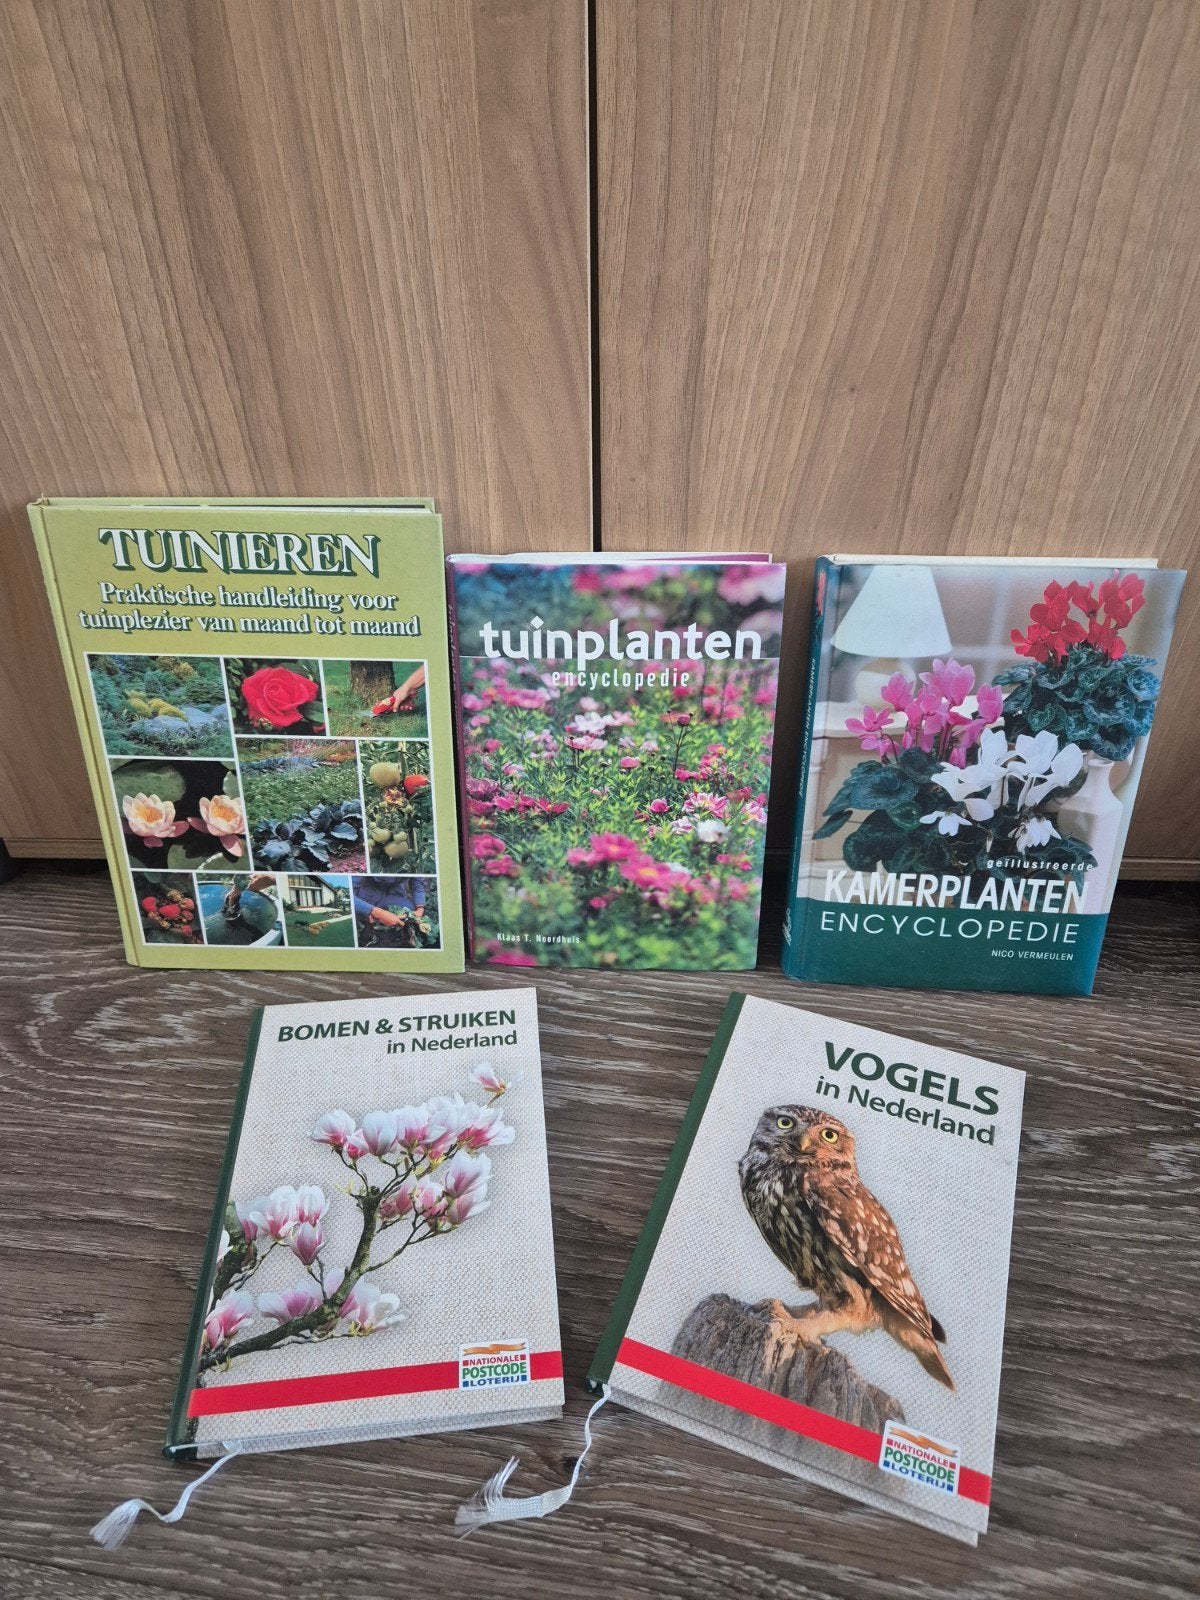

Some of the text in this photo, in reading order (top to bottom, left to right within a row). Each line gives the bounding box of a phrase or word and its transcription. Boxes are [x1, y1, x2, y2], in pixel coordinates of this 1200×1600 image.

[99, 528, 381, 578] TUINIEREN
[99, 581, 398, 613] Praktische handleiding voor
[78, 608, 421, 637] tuinplezier van maand tot maand
[479, 615, 762, 671] tuinplanten
[551, 668, 690, 691] encyclopedie
[986, 857, 1094, 871] geïllustreerde
[824, 869, 1090, 914] KAMERPLANTEN
[497, 932, 580, 944] Klaas T. Noordhuis
[820, 911, 1080, 944] ENCYCLOPEDIE
[991, 949, 1074, 961] NICO VERMEULEN
[277, 1009, 516, 1042] BOMEN & STRUIKEN
[386, 1030, 518, 1054] in Nederland
[825, 1041, 999, 1116] VOGELS
[815, 1075, 995, 1146] in Nederland
[462, 1361, 527, 1379] POSTCODE
[469, 1354, 519, 1366] NATIONALE
[470, 1375, 520, 1387] LOTERIJ
[884, 1446, 955, 1484] POSTCODE
[893, 1440, 949, 1467] NATIONALE
[891, 1462, 946, 1489] LOTERIJ
